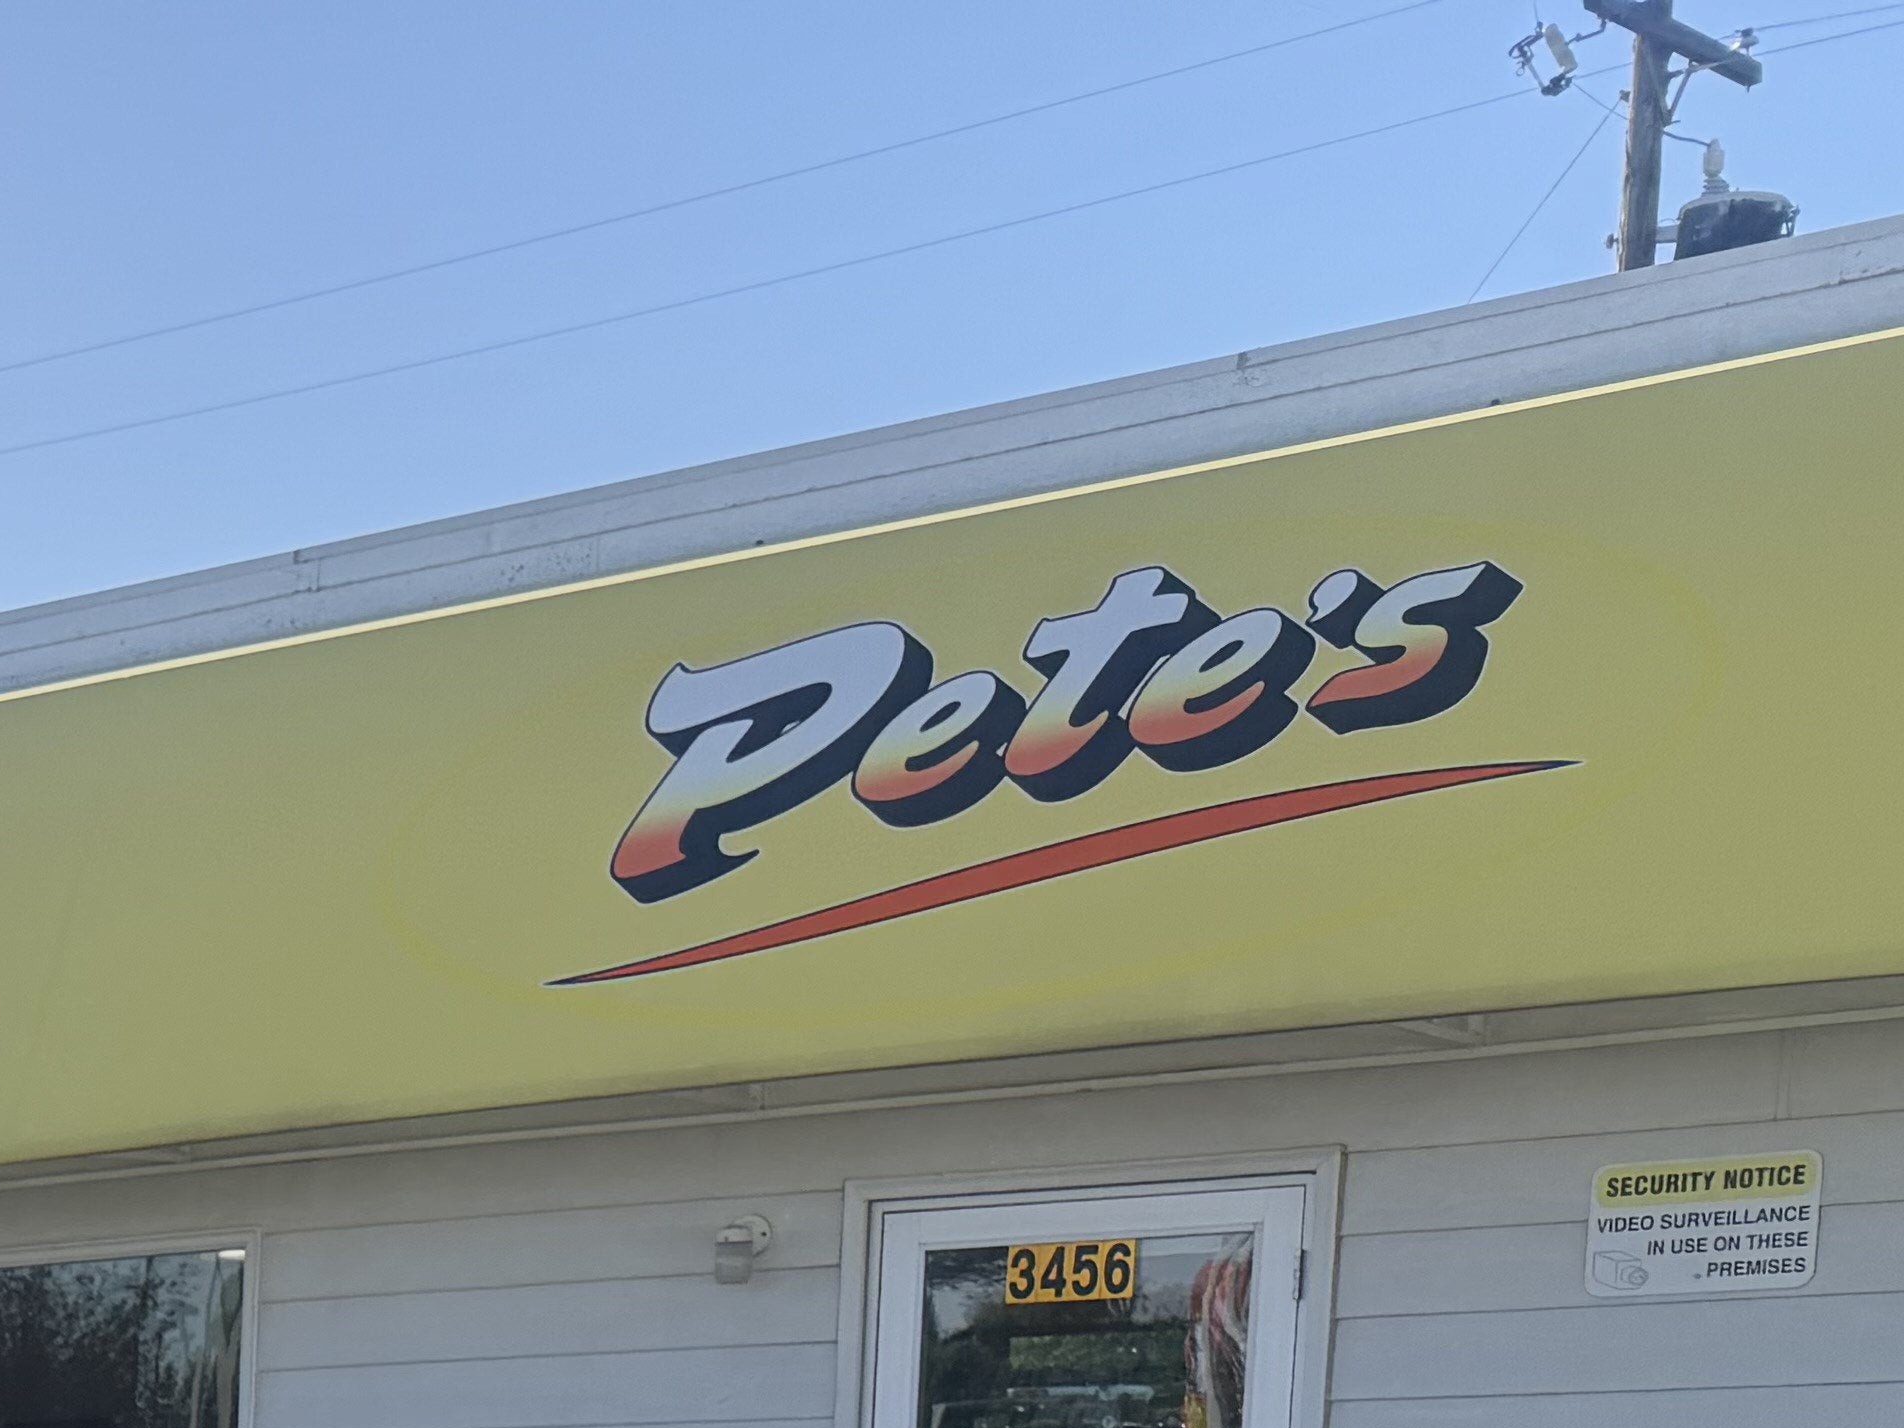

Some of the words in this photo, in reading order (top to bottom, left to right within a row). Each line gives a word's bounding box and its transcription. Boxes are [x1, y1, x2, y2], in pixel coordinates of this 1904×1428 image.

[611, 561, 1523, 903] Pete's
[1606, 1171, 1716, 1198] SECURITY
[1723, 1165, 1806, 1190] NOTICE
[1597, 1215, 1654, 1234] VIDEO
[1661, 1205, 1811, 1230] SURVEILLANCE
[1647, 1240, 1665, 1256] IN
[1671, 1237, 1708, 1254] USE
[1713, 1234, 1741, 1252] ON
[1747, 1231, 1809, 1250] THESE
[1008, 1242, 1132, 1300] 3456
[1707, 1258, 1807, 1279] PREMISES
